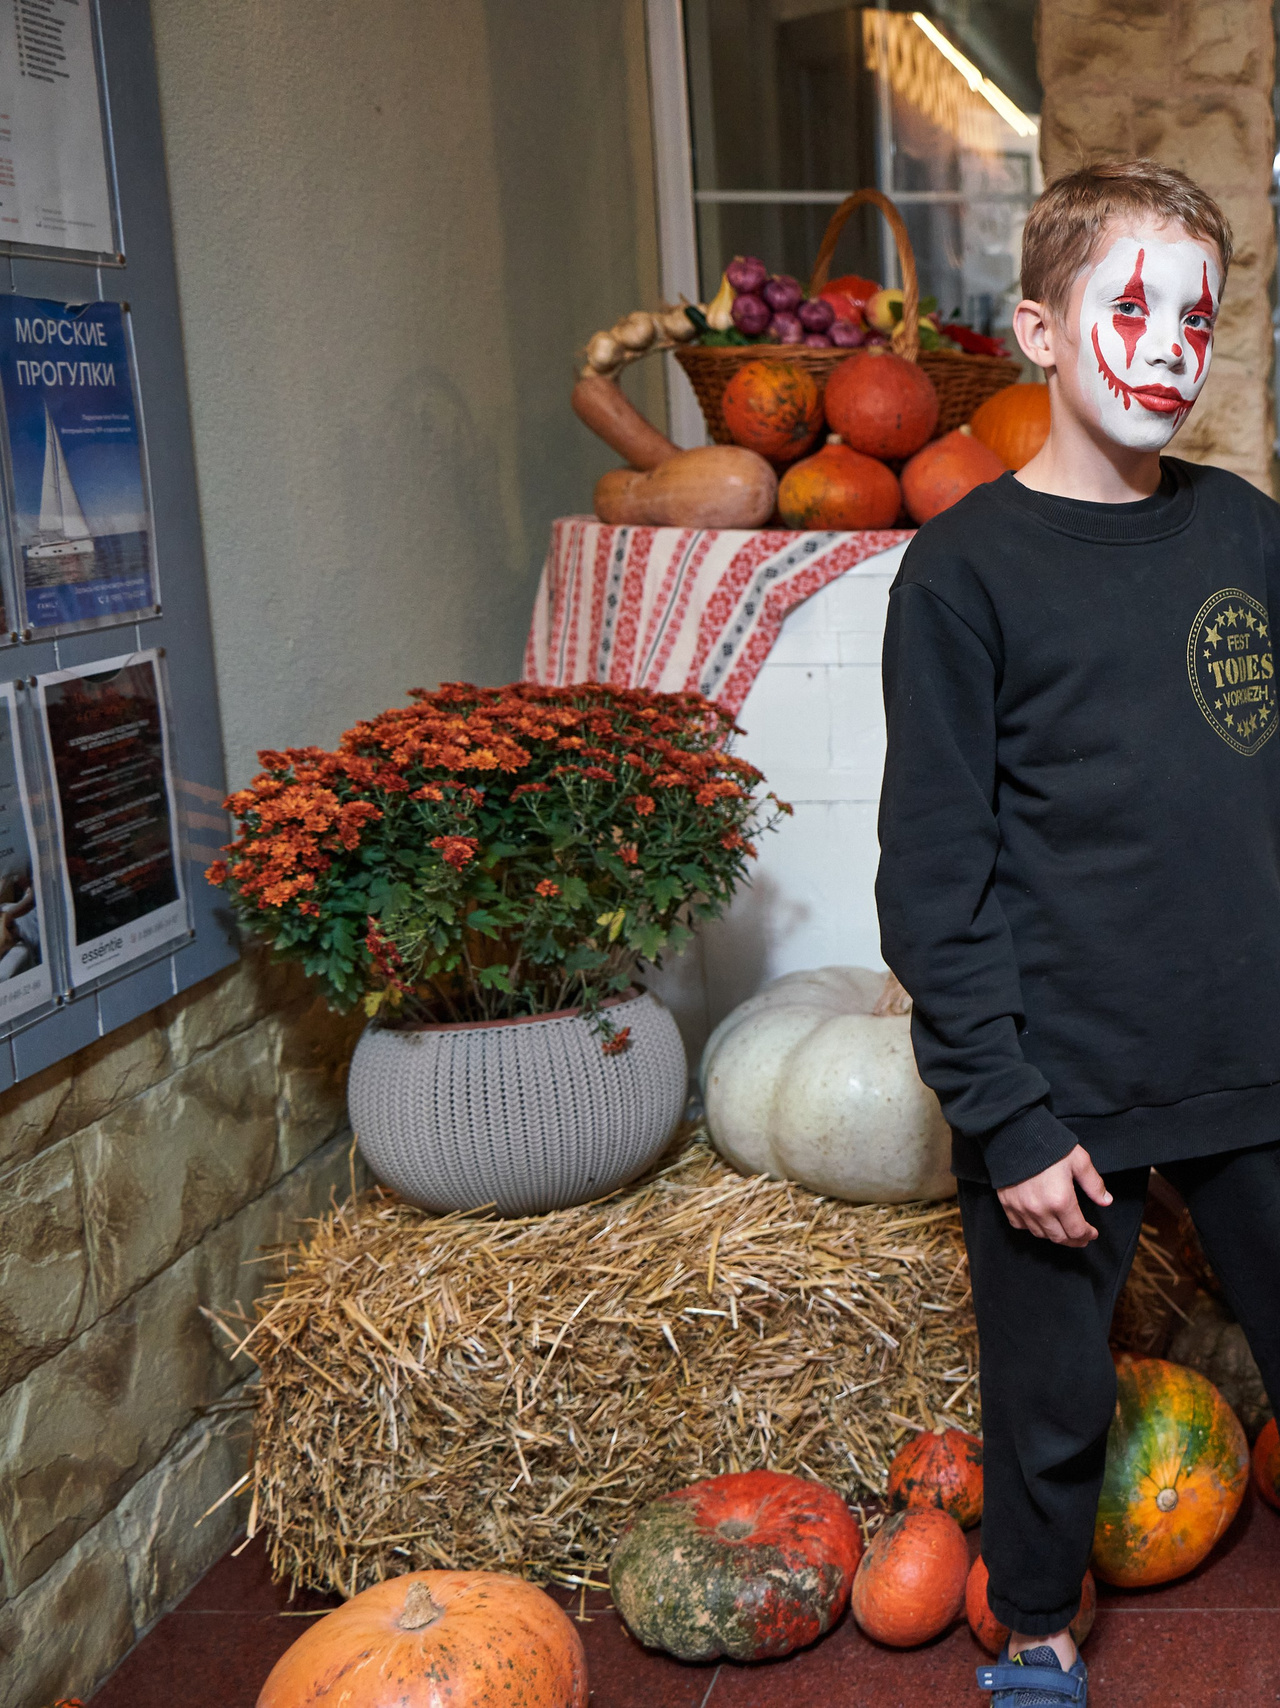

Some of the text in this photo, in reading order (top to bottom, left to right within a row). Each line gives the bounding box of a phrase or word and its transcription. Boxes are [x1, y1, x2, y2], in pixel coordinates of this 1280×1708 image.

[15, 317, 108, 347] МОРСКИЕ
[16, 360, 116, 387] ПРОГУЛКИ
[1227, 633, 1250, 652] FEST
[1207, 653, 1274, 688] TODES
